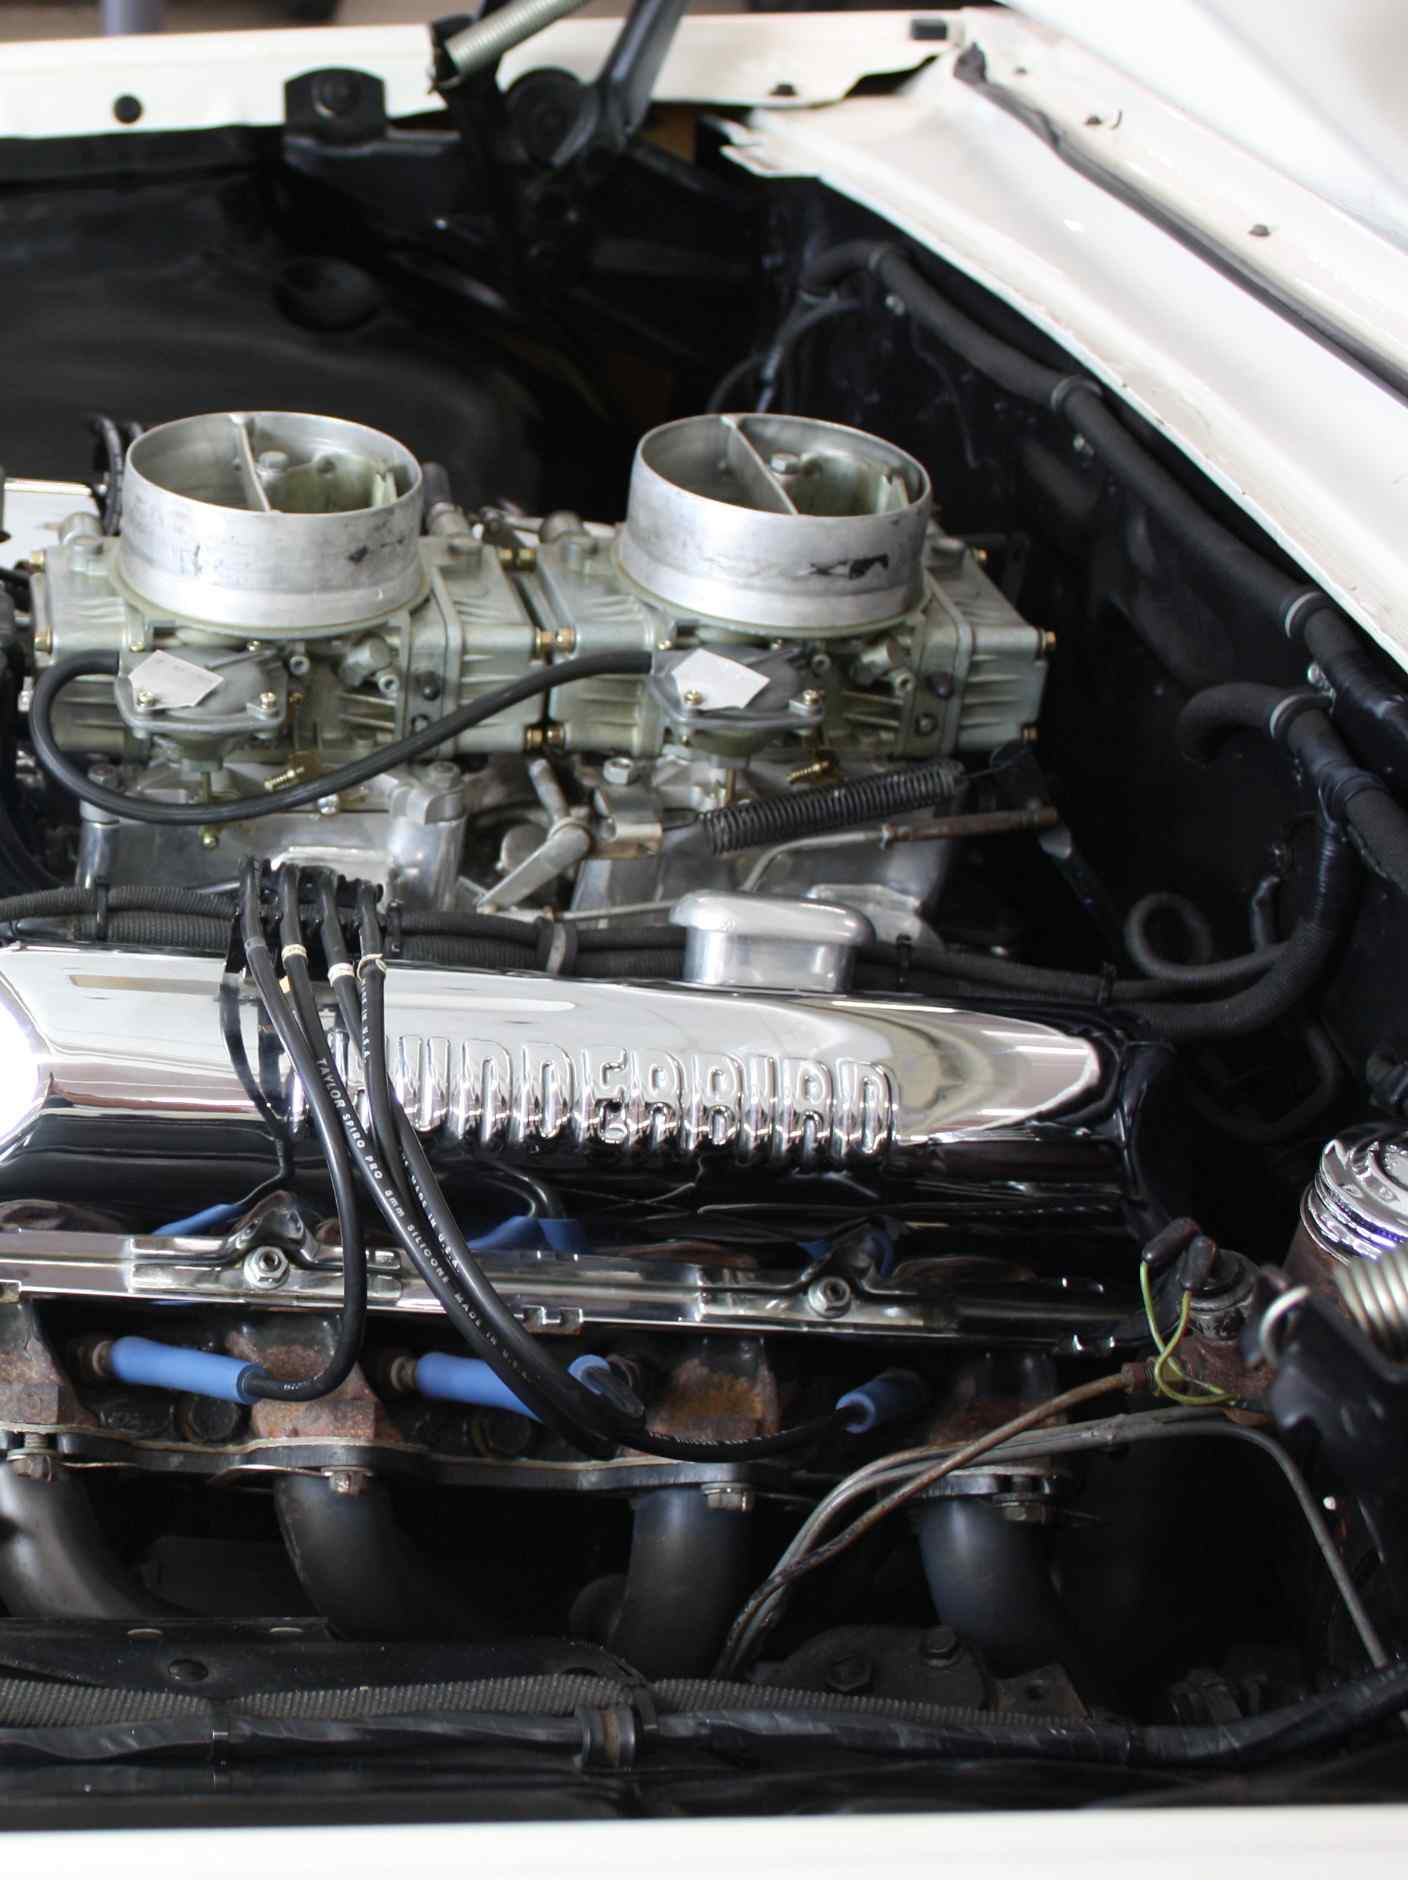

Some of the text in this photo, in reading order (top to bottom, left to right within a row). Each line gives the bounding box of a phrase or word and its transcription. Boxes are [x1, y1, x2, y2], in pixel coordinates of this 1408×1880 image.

[286, 1026, 899, 1168] UNDERBIRD
[316, 1057, 347, 1109] TAYLOR
[342, 1112, 367, 1150] SPIRO
[364, 1154, 384, 1181] PRO
[407, 1223, 450, 1284] SILICONE
